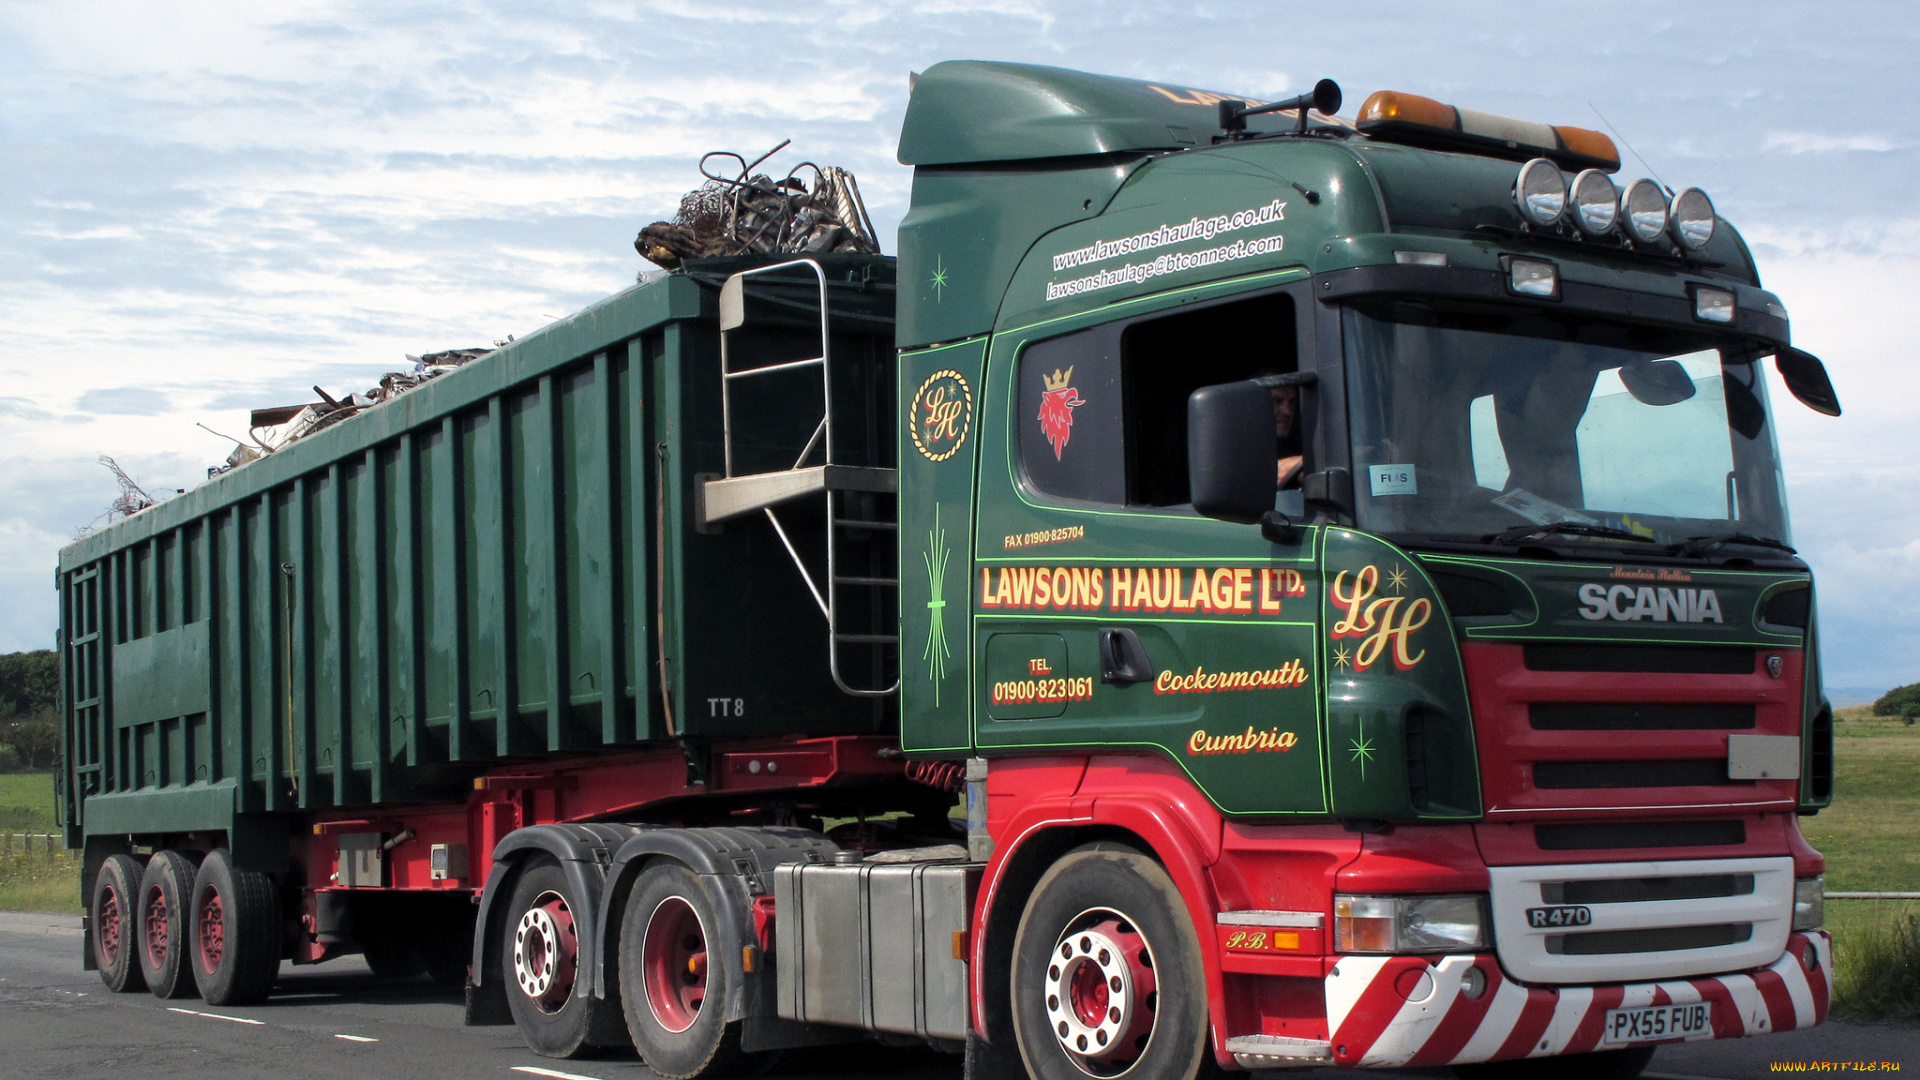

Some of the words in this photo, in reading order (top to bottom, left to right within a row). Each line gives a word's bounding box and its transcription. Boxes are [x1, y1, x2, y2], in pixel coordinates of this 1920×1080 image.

[1053, 199, 1287, 271] www.lawsonshaulage.co.uk
[1046, 235, 1283, 301] lawsonshaulage@btconnect.com
[1004, 530, 1023, 549] FAX
[981, 567, 1104, 609] LAWSONS
[1111, 567, 1252, 613] HAULAGE
[1578, 583, 1724, 624] SCANIA
[1029, 658, 1052, 675] TEL.
[1155, 658, 1309, 695] Cockermouth
[1188, 725, 1298, 755] Cumbria
[1532, 909, 1547, 926] R
[1549, 907, 1590, 925] 470
[1614, 1008, 1667, 1038] PX55
[1670, 1005, 1705, 1032] FUB
